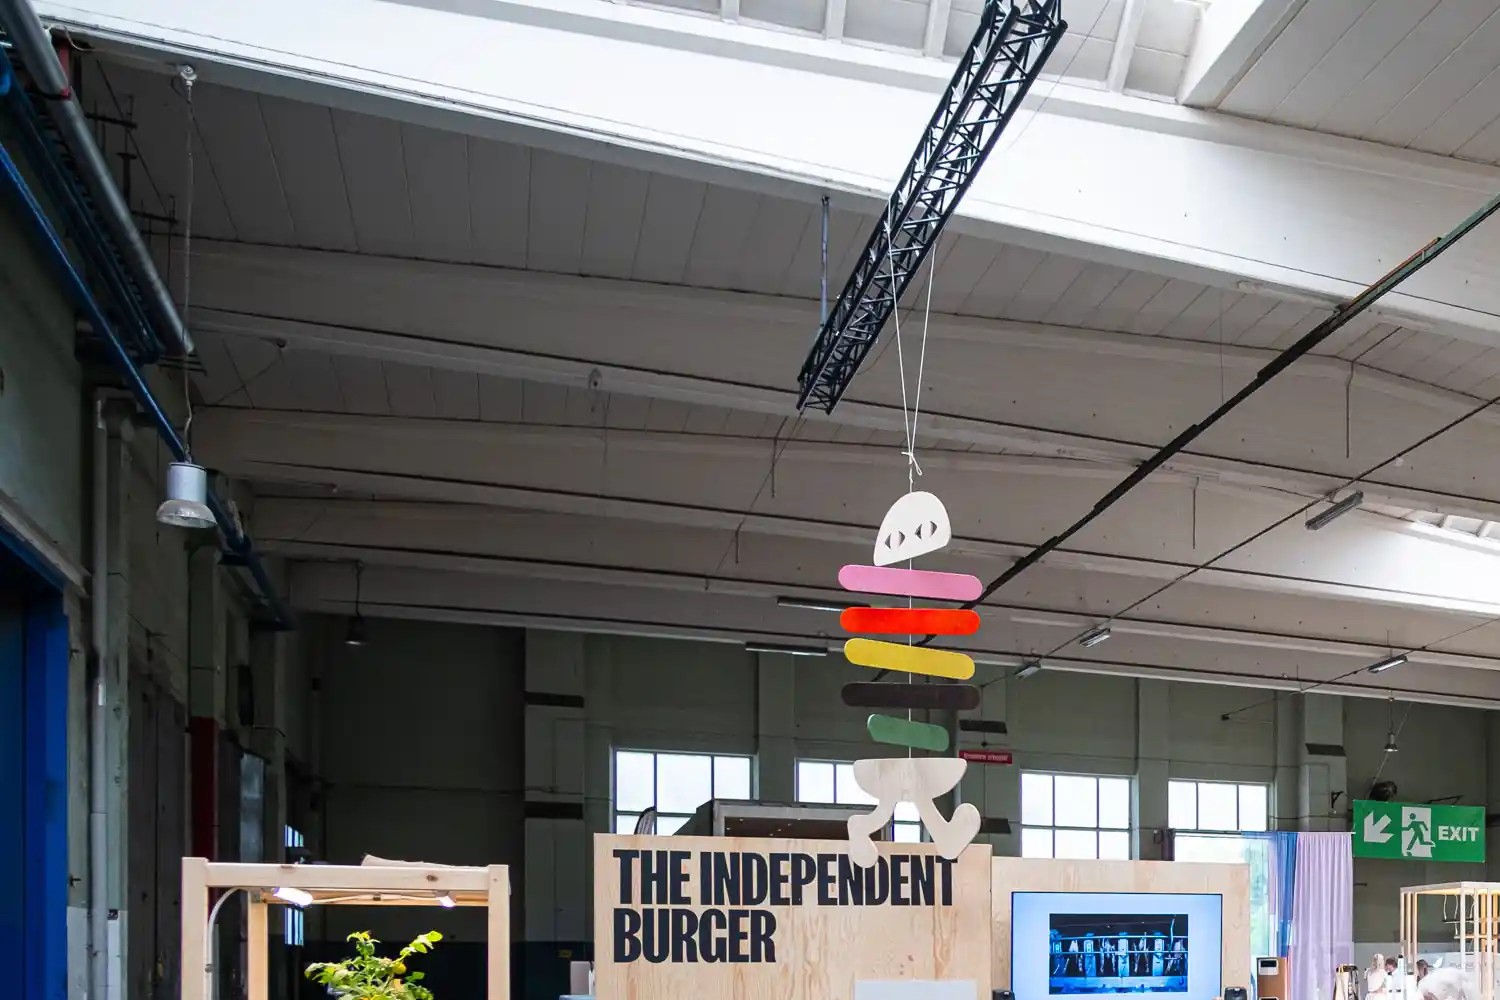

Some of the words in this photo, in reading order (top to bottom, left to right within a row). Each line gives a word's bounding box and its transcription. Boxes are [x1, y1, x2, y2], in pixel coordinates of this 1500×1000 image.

[1438, 826, 1479, 842] EXIT
[613, 849, 691, 905] THE
[700, 851, 958, 906] INDEPENDENT
[614, 908, 777, 963] BURGER
